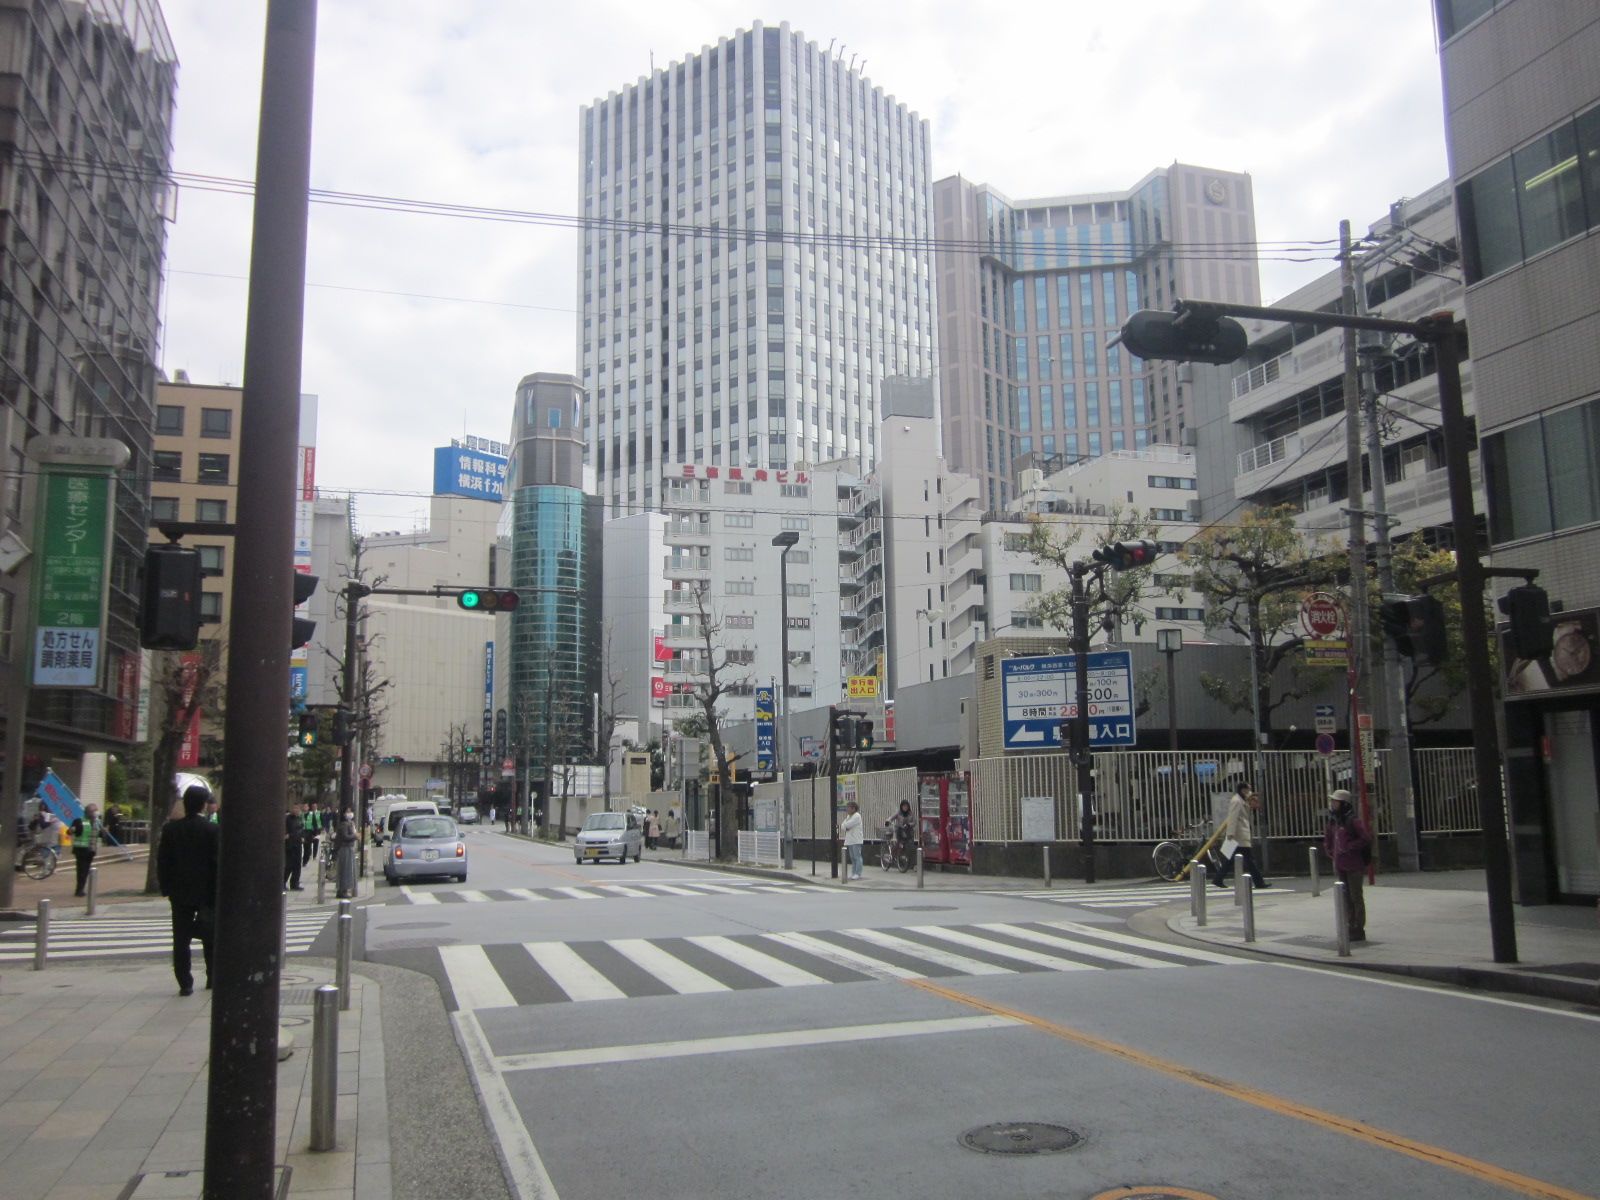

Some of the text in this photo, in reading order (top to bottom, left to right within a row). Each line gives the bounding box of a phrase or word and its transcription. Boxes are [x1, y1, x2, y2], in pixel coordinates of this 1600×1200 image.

[65, 477, 89, 555] 医療センター
[1310, 610, 1336, 625] 消火栓
[43, 631, 93, 649] 処方せん
[41, 650, 92, 669] 調剤薬局
[1022, 707, 1047, 717] 8時間
[1053, 724, 1130, 740] 駐場入口
